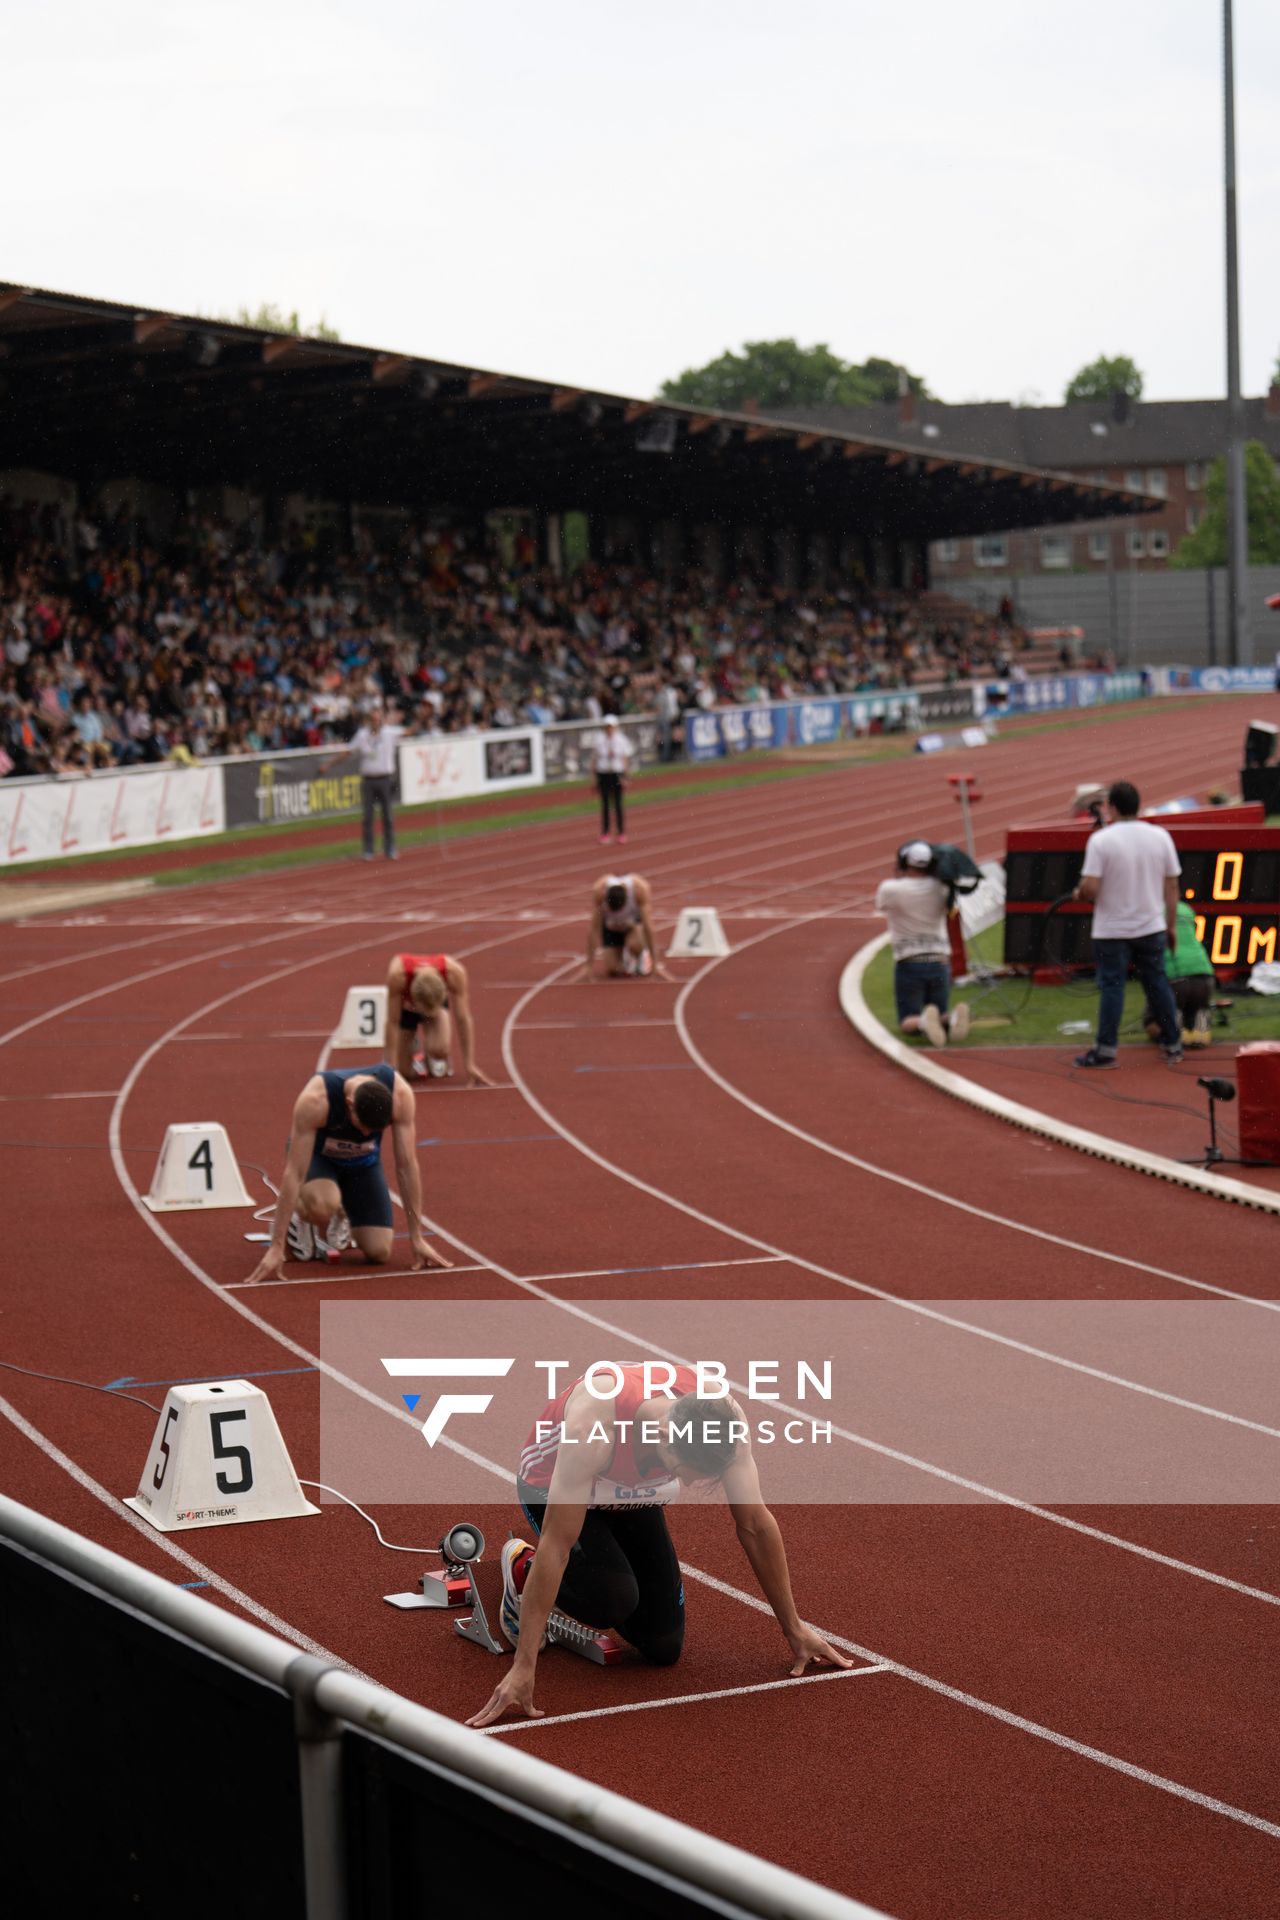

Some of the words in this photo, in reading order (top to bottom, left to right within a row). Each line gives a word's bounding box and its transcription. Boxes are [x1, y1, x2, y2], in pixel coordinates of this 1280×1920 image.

[272, 774, 362, 817] TRUEATHLET
[688, 918, 703, 947] 2
[1195, 915, 1277, 964] 0M
[358, 999, 377, 1036] 3
[188, 1139, 213, 1191] 4
[153, 1406, 179, 1491] 5
[209, 1409, 253, 1494] 5
[615, 1486, 657, 1499] GLS
